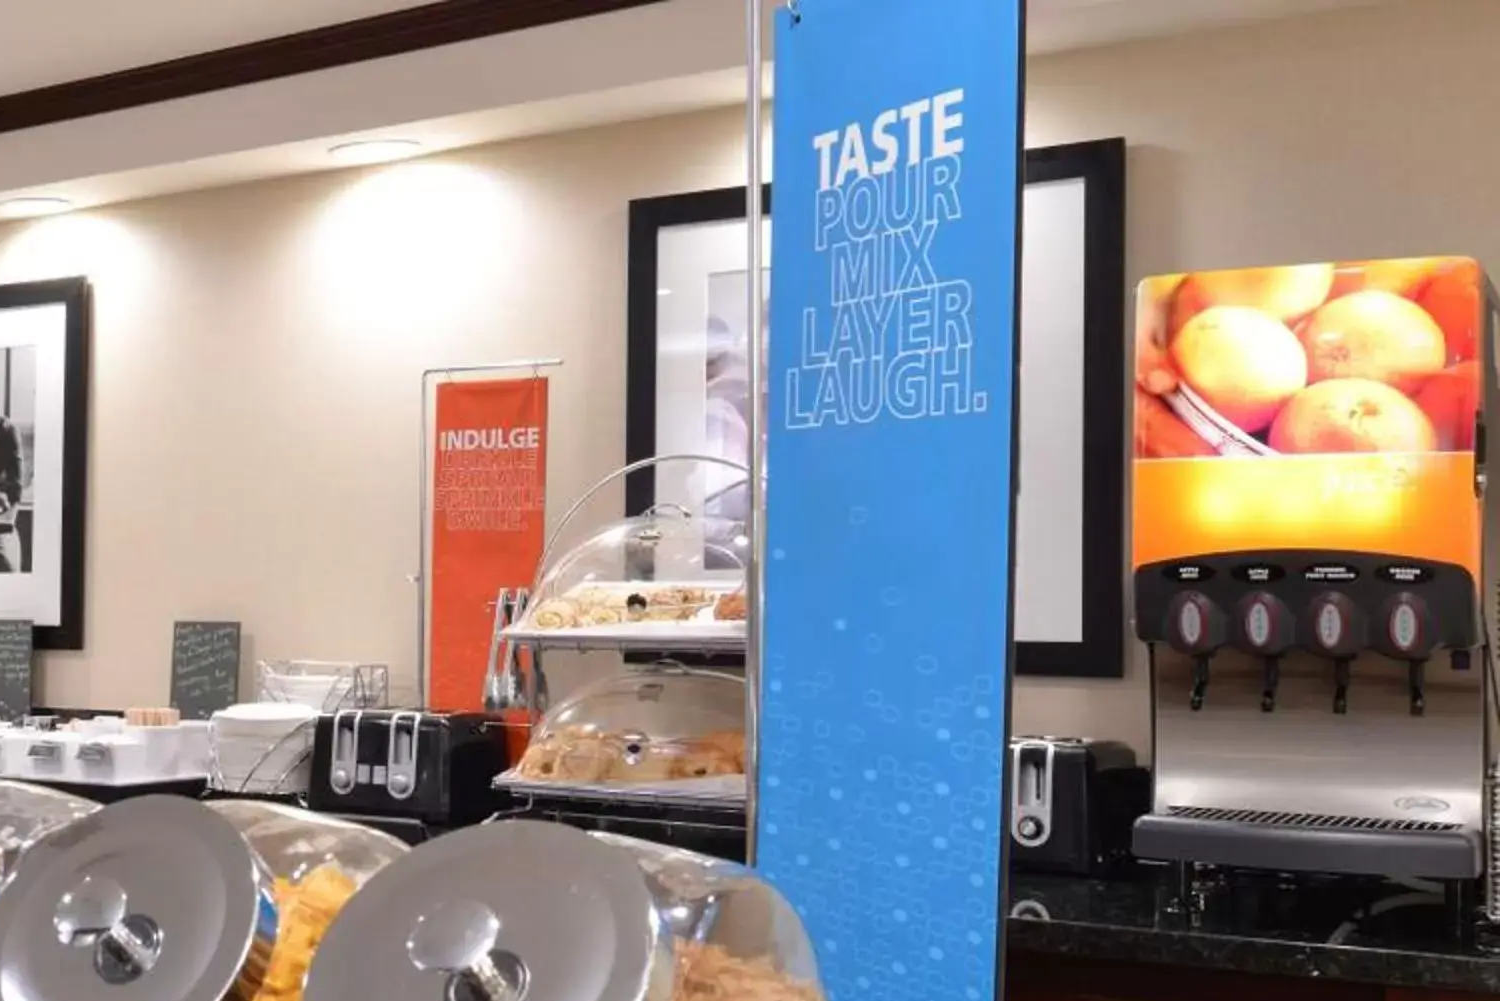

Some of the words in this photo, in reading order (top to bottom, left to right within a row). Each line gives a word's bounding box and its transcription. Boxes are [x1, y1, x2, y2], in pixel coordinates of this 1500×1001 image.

[813, 88, 965, 190] TASTE
[815, 154, 961, 251] POUR
[831, 219, 939, 306] MIX
[802, 280, 973, 369] LAYER
[785, 347, 987, 429] LAUGH.
[440, 427, 540, 451] INDULGE
